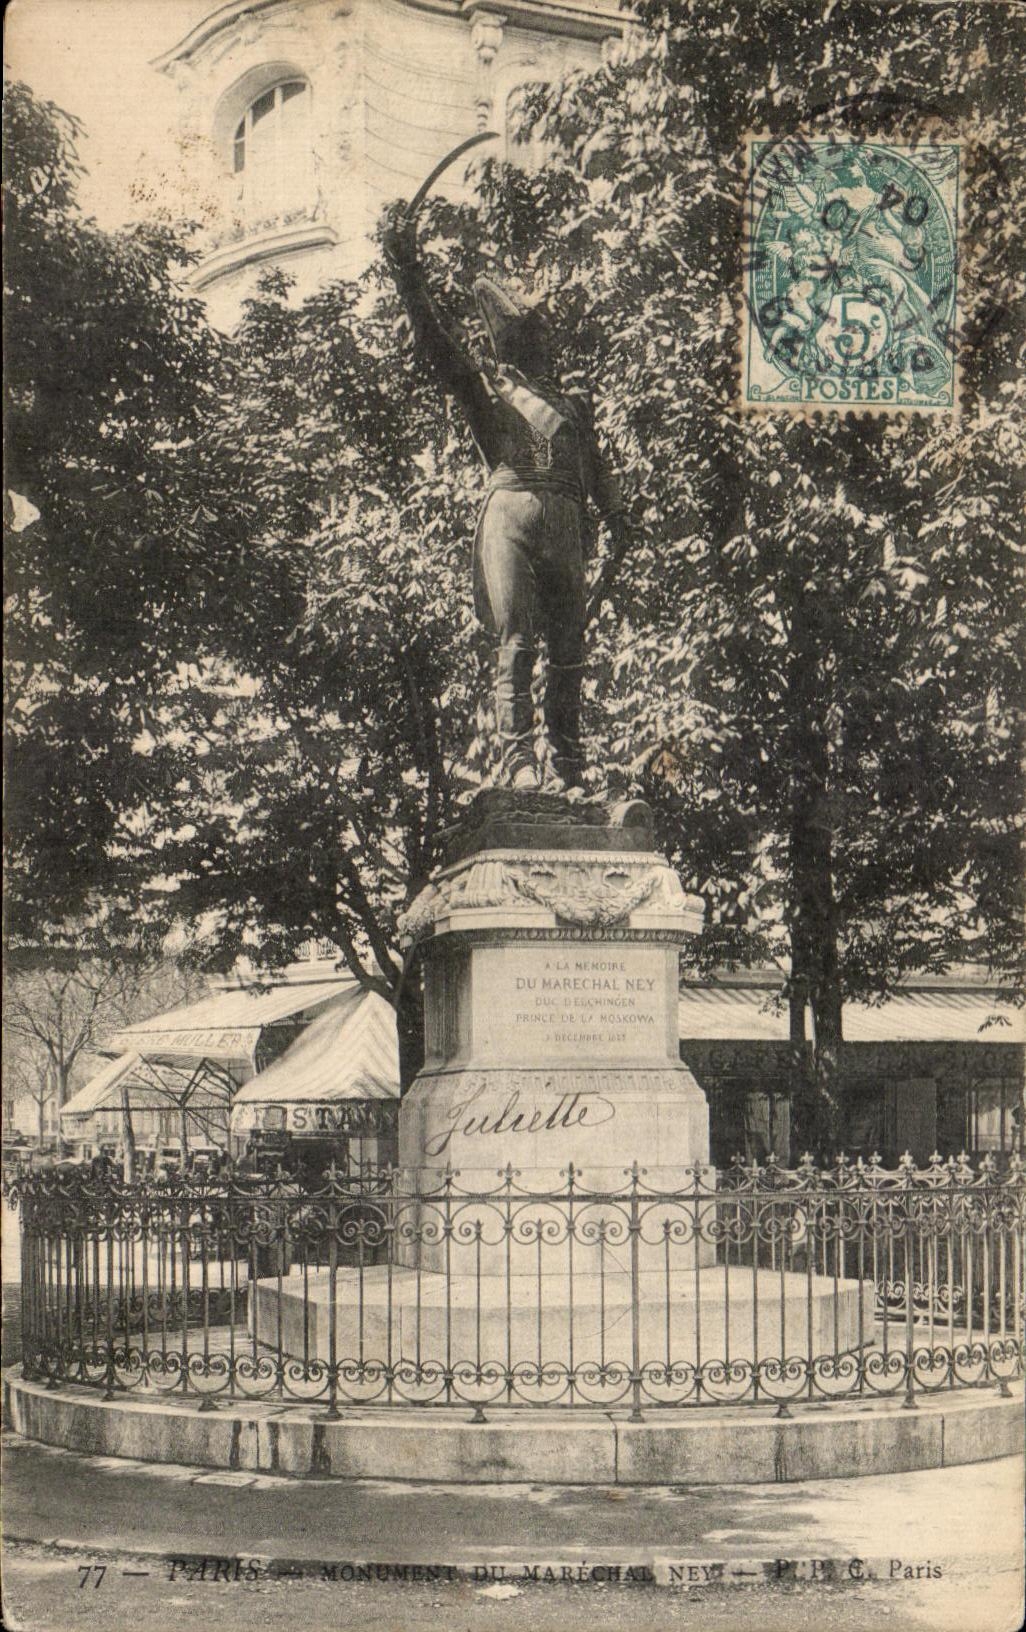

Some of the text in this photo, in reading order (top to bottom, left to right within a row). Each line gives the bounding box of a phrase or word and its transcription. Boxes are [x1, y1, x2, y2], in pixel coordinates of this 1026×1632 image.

[805, 380, 894, 400] POSTES
[556, 961, 570, 971] LA
[575, 961, 626, 972] MEMOIRE
[515, 977, 656, 991] DU MARECHAL NEY
[535, 996, 559, 1007] DUC
[515, 1013, 655, 1025] PRINCE DE LA MOSKOWA
[424, 1082, 616, 1156] Juliette
